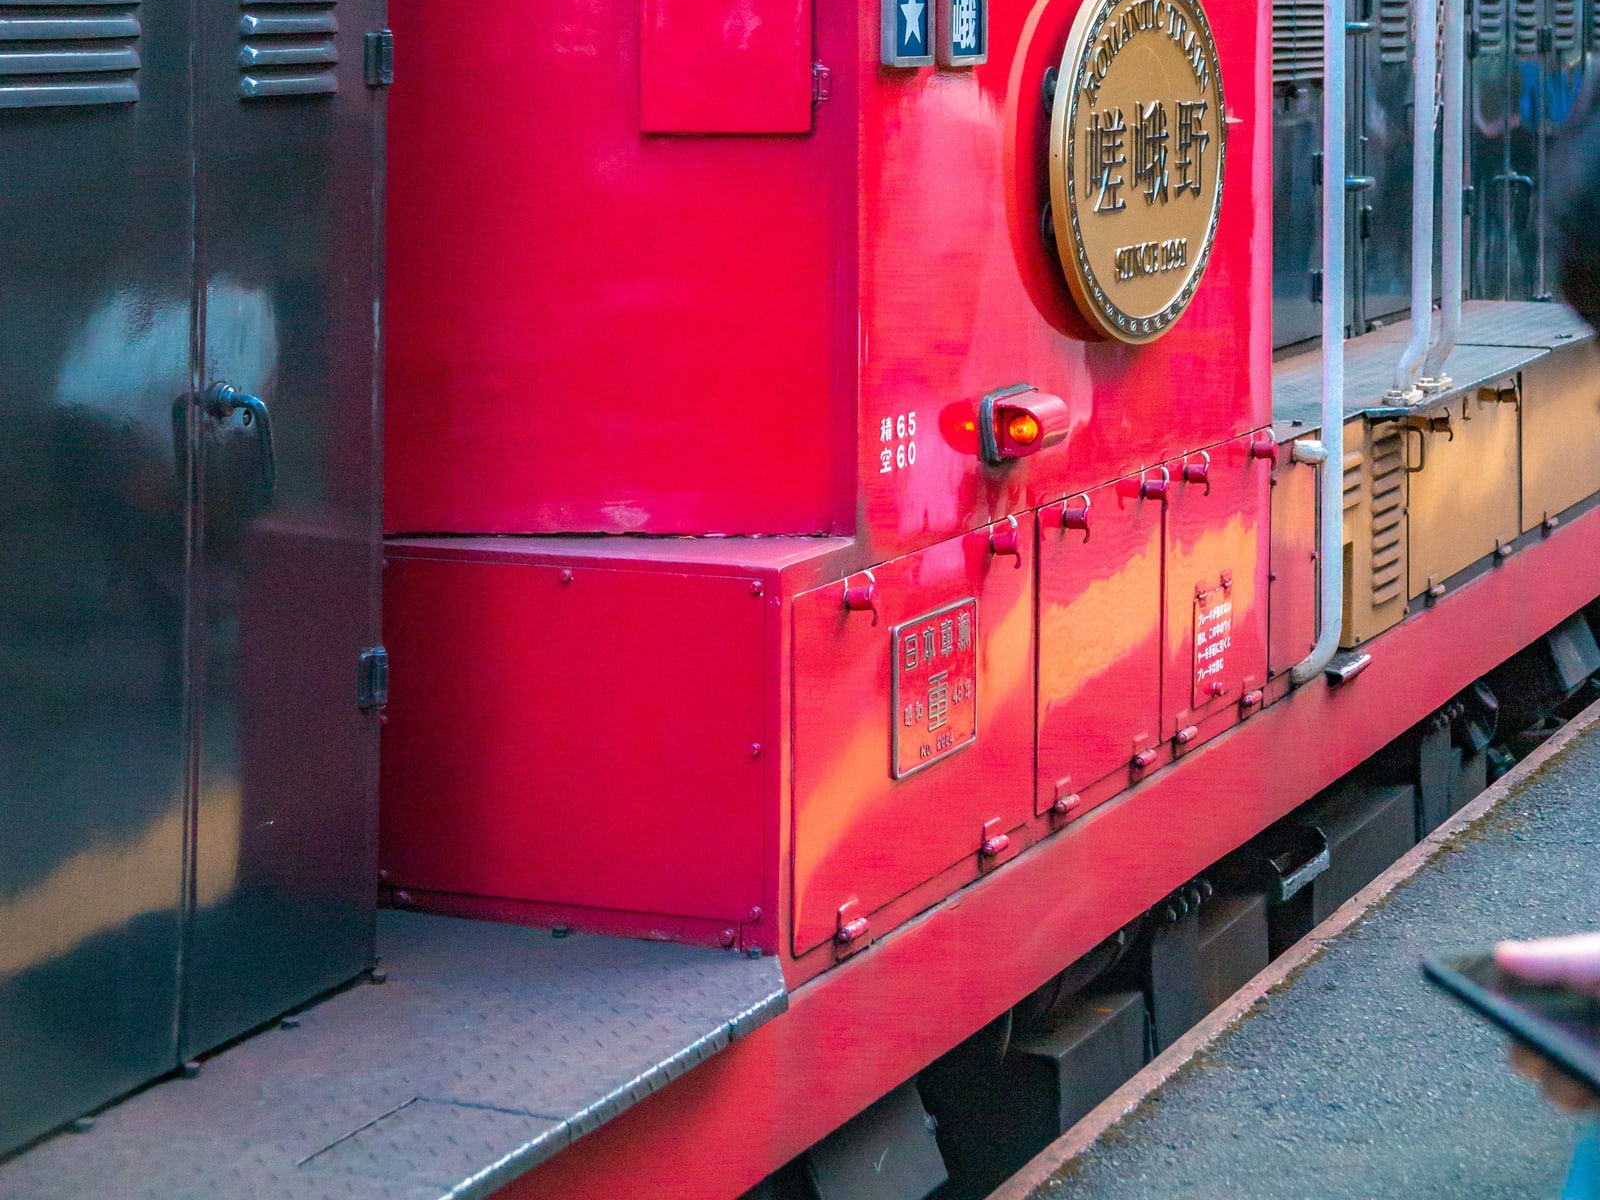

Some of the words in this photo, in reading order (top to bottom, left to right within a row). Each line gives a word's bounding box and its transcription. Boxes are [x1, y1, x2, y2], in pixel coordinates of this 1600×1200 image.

[1165, 3, 1210, 95] TRAIN
[1085, 99, 1210, 214] 嵯峨野
[1115, 241, 1159, 281] SINCE
[1161, 237, 1187, 271] 1991
[896, 411, 916, 439] 6.5
[879, 447, 893, 474] 空
[896, 441, 916, 469] 6.0
